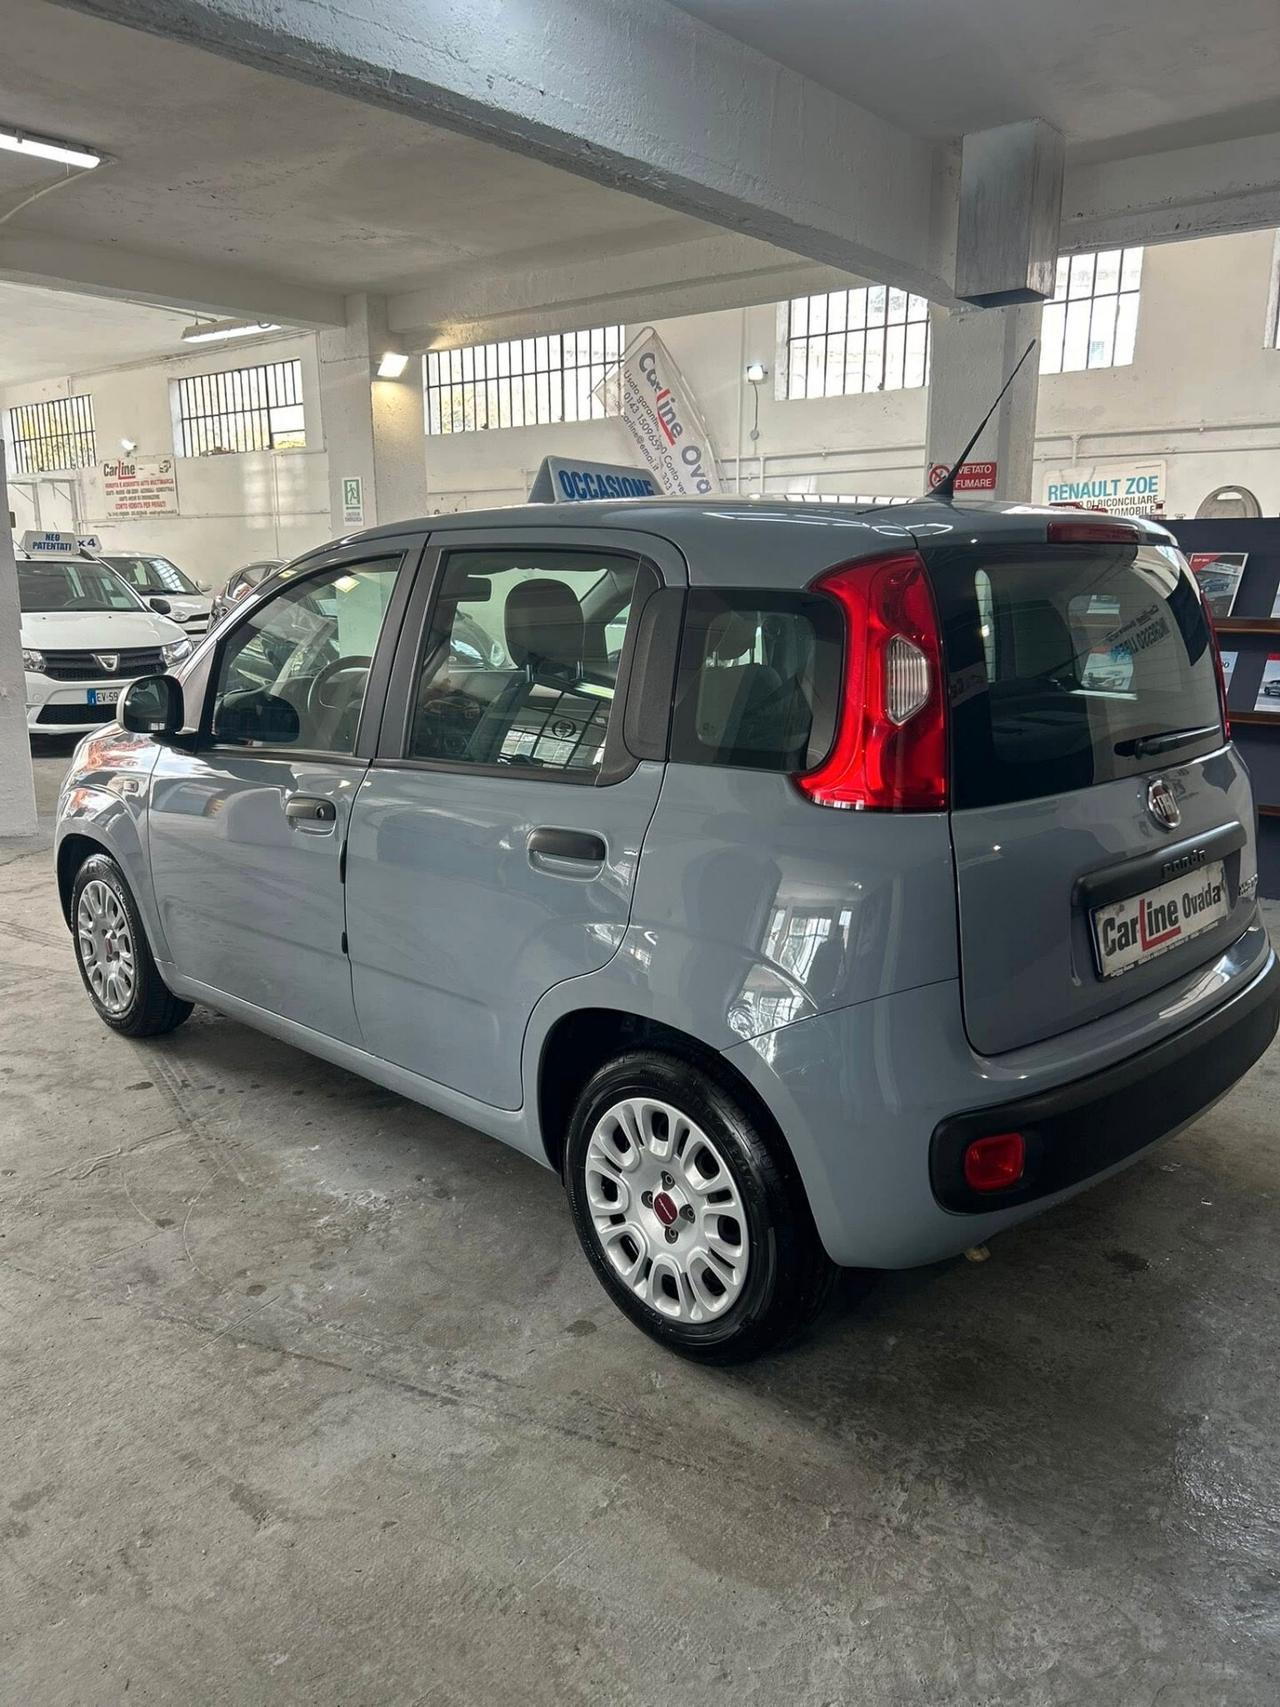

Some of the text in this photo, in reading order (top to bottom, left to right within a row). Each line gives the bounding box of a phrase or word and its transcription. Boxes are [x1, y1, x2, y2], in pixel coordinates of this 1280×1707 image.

[623, 392, 640, 415] 0143
[624, 370, 640, 396] Usato
[663, 454, 679, 481] Conto
[103, 460, 136, 479] CarLine
[957, 464, 993, 475] VIETATO
[558, 470, 655, 499] OCCASIONE
[955, 478, 993, 489] FUMARE
[1048, 475, 1158, 501] RENAULT ZOE
[1109, 505, 1155, 516] TOMOBILE
[32, 542, 72, 551] PATENTATI
[45, 533, 60, 542] NEO
[1102, 898, 1182, 958] CarLine
[1182, 882, 1222, 919] Ovada
